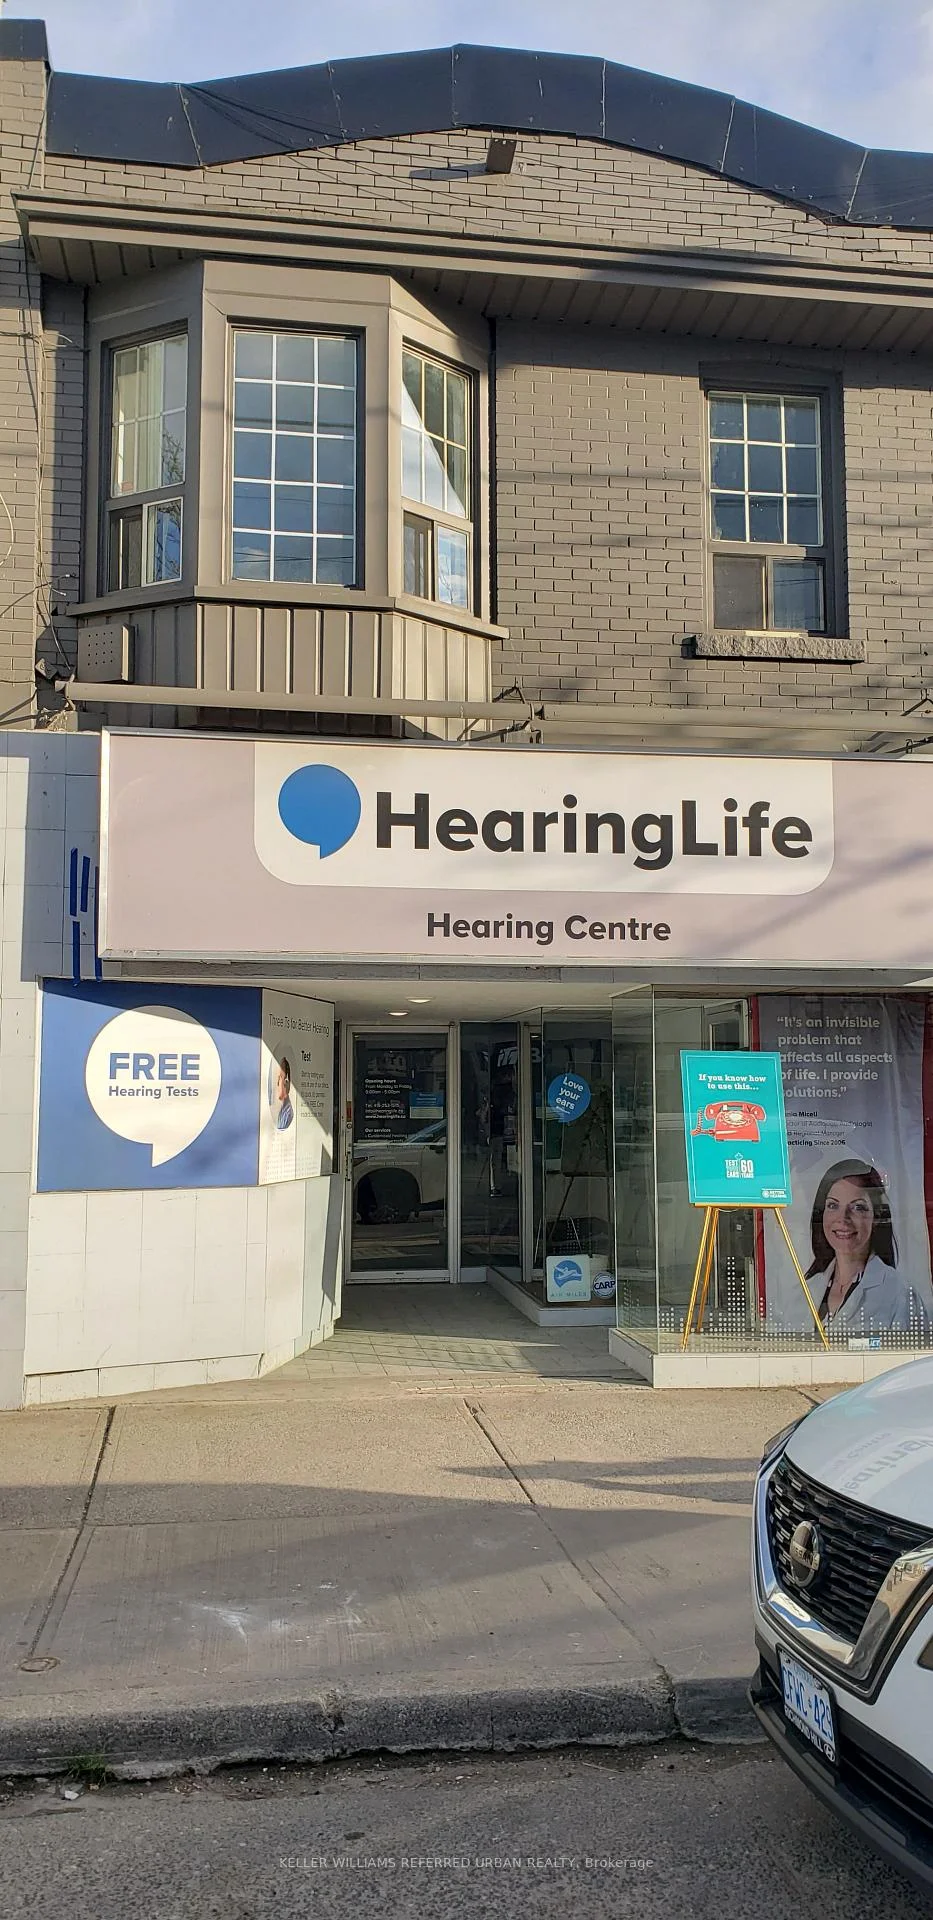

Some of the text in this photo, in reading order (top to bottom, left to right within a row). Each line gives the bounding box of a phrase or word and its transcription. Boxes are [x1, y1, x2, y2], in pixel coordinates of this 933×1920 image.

[376, 791, 813, 870] HearingLife
[427, 912, 671, 945] Hearing Centre
[805, 1018, 823, 1028] an
[826, 1016, 880, 1028] invisible
[778, 1034, 862, 1047] problem that
[301, 1050, 311, 1062] Test
[780, 1052, 893, 1064] affects all aspects
[109, 1052, 200, 1080] FREE
[725, 1074, 747, 1082] know
[794, 1069, 820, 1080] life.
[823, 1069, 827, 1080] I
[830, 1069, 879, 1082] provide
[562, 1076, 584, 1092] Love
[108, 1085, 199, 1099] Hearing Tests
[559, 1087, 580, 1101] your
[555, 1096, 575, 1110] ears
[740, 1160, 754, 1173] 60
[594, 1281, 616, 1290] CARP
